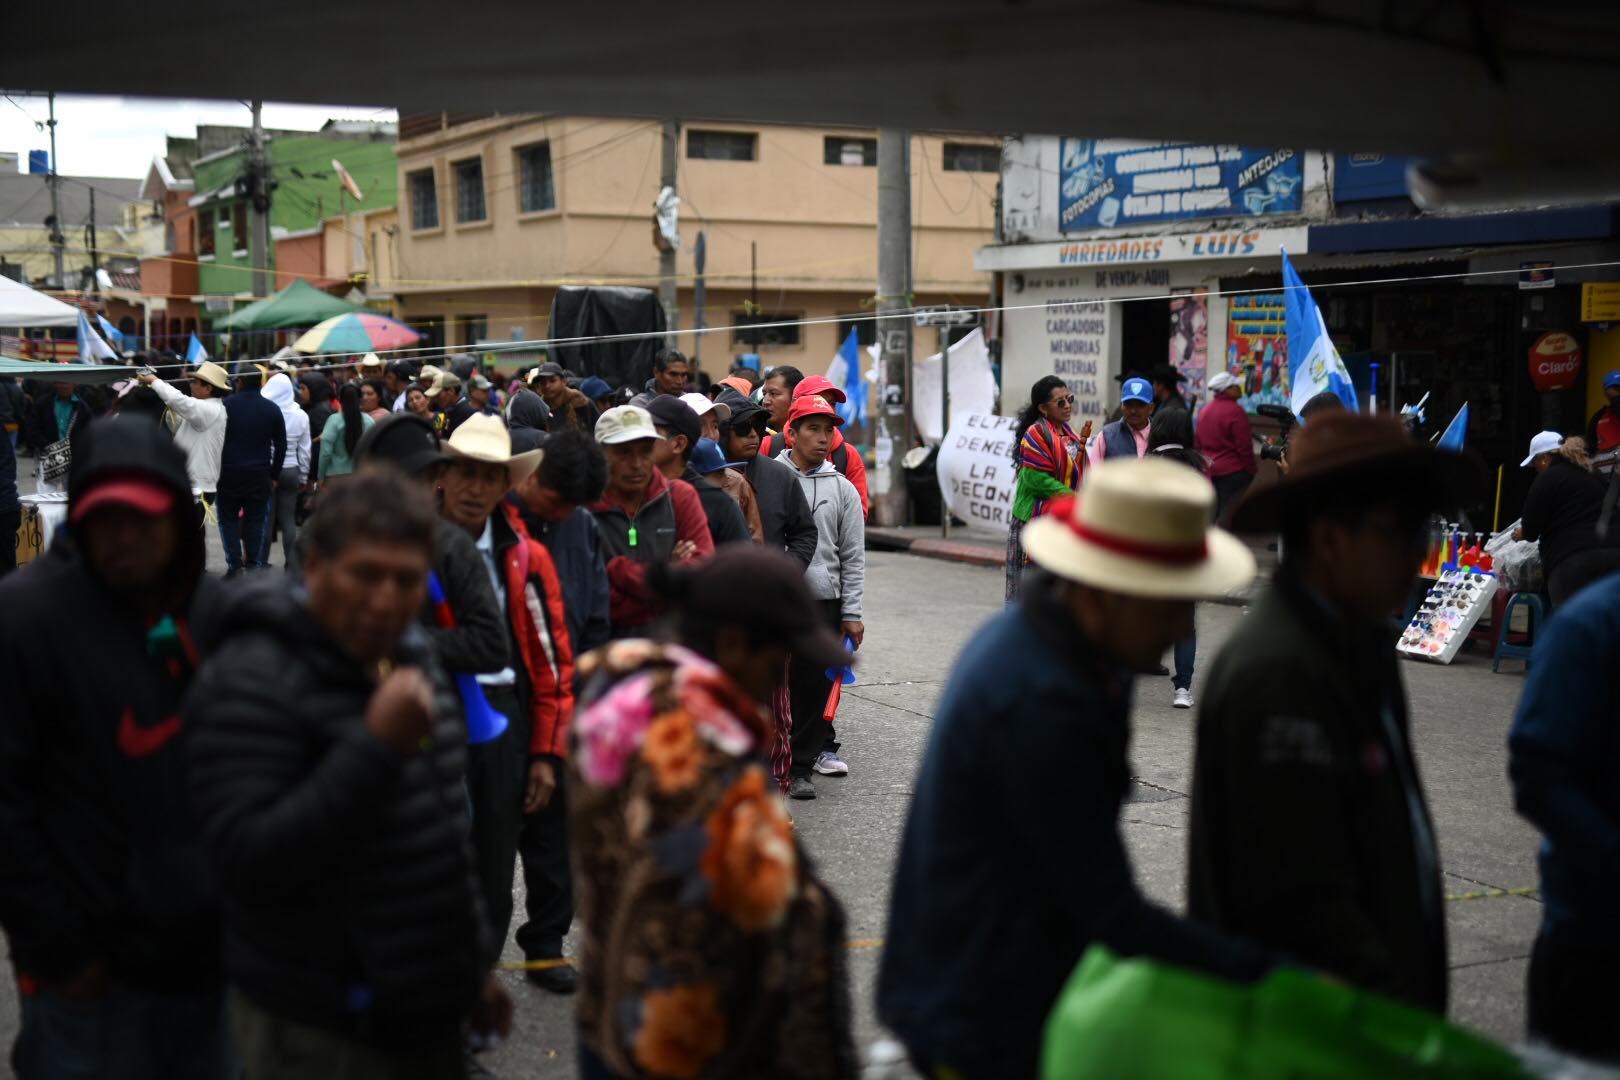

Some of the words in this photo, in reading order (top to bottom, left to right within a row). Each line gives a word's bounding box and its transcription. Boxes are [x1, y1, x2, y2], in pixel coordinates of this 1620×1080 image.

[1238, 147, 1295, 188] ANTEOJOS
[1062, 177, 1115, 224] FOTOCOPIAS
[1059, 239, 1163, 263] VARIEDADES
[1193, 232, 1260, 256] LUIS
[1109, 269, 1136, 287] VENTA
[1046, 297, 1105, 315] FOTOCOPIAS
[1046, 318, 1105, 336] CARGADORES
[1051, 339, 1101, 356] MEMORIAS
[1054, 358, 1097, 376] BATERIAS
[1538, 359, 1574, 375] Claro
[970, 463, 997, 480] LA
